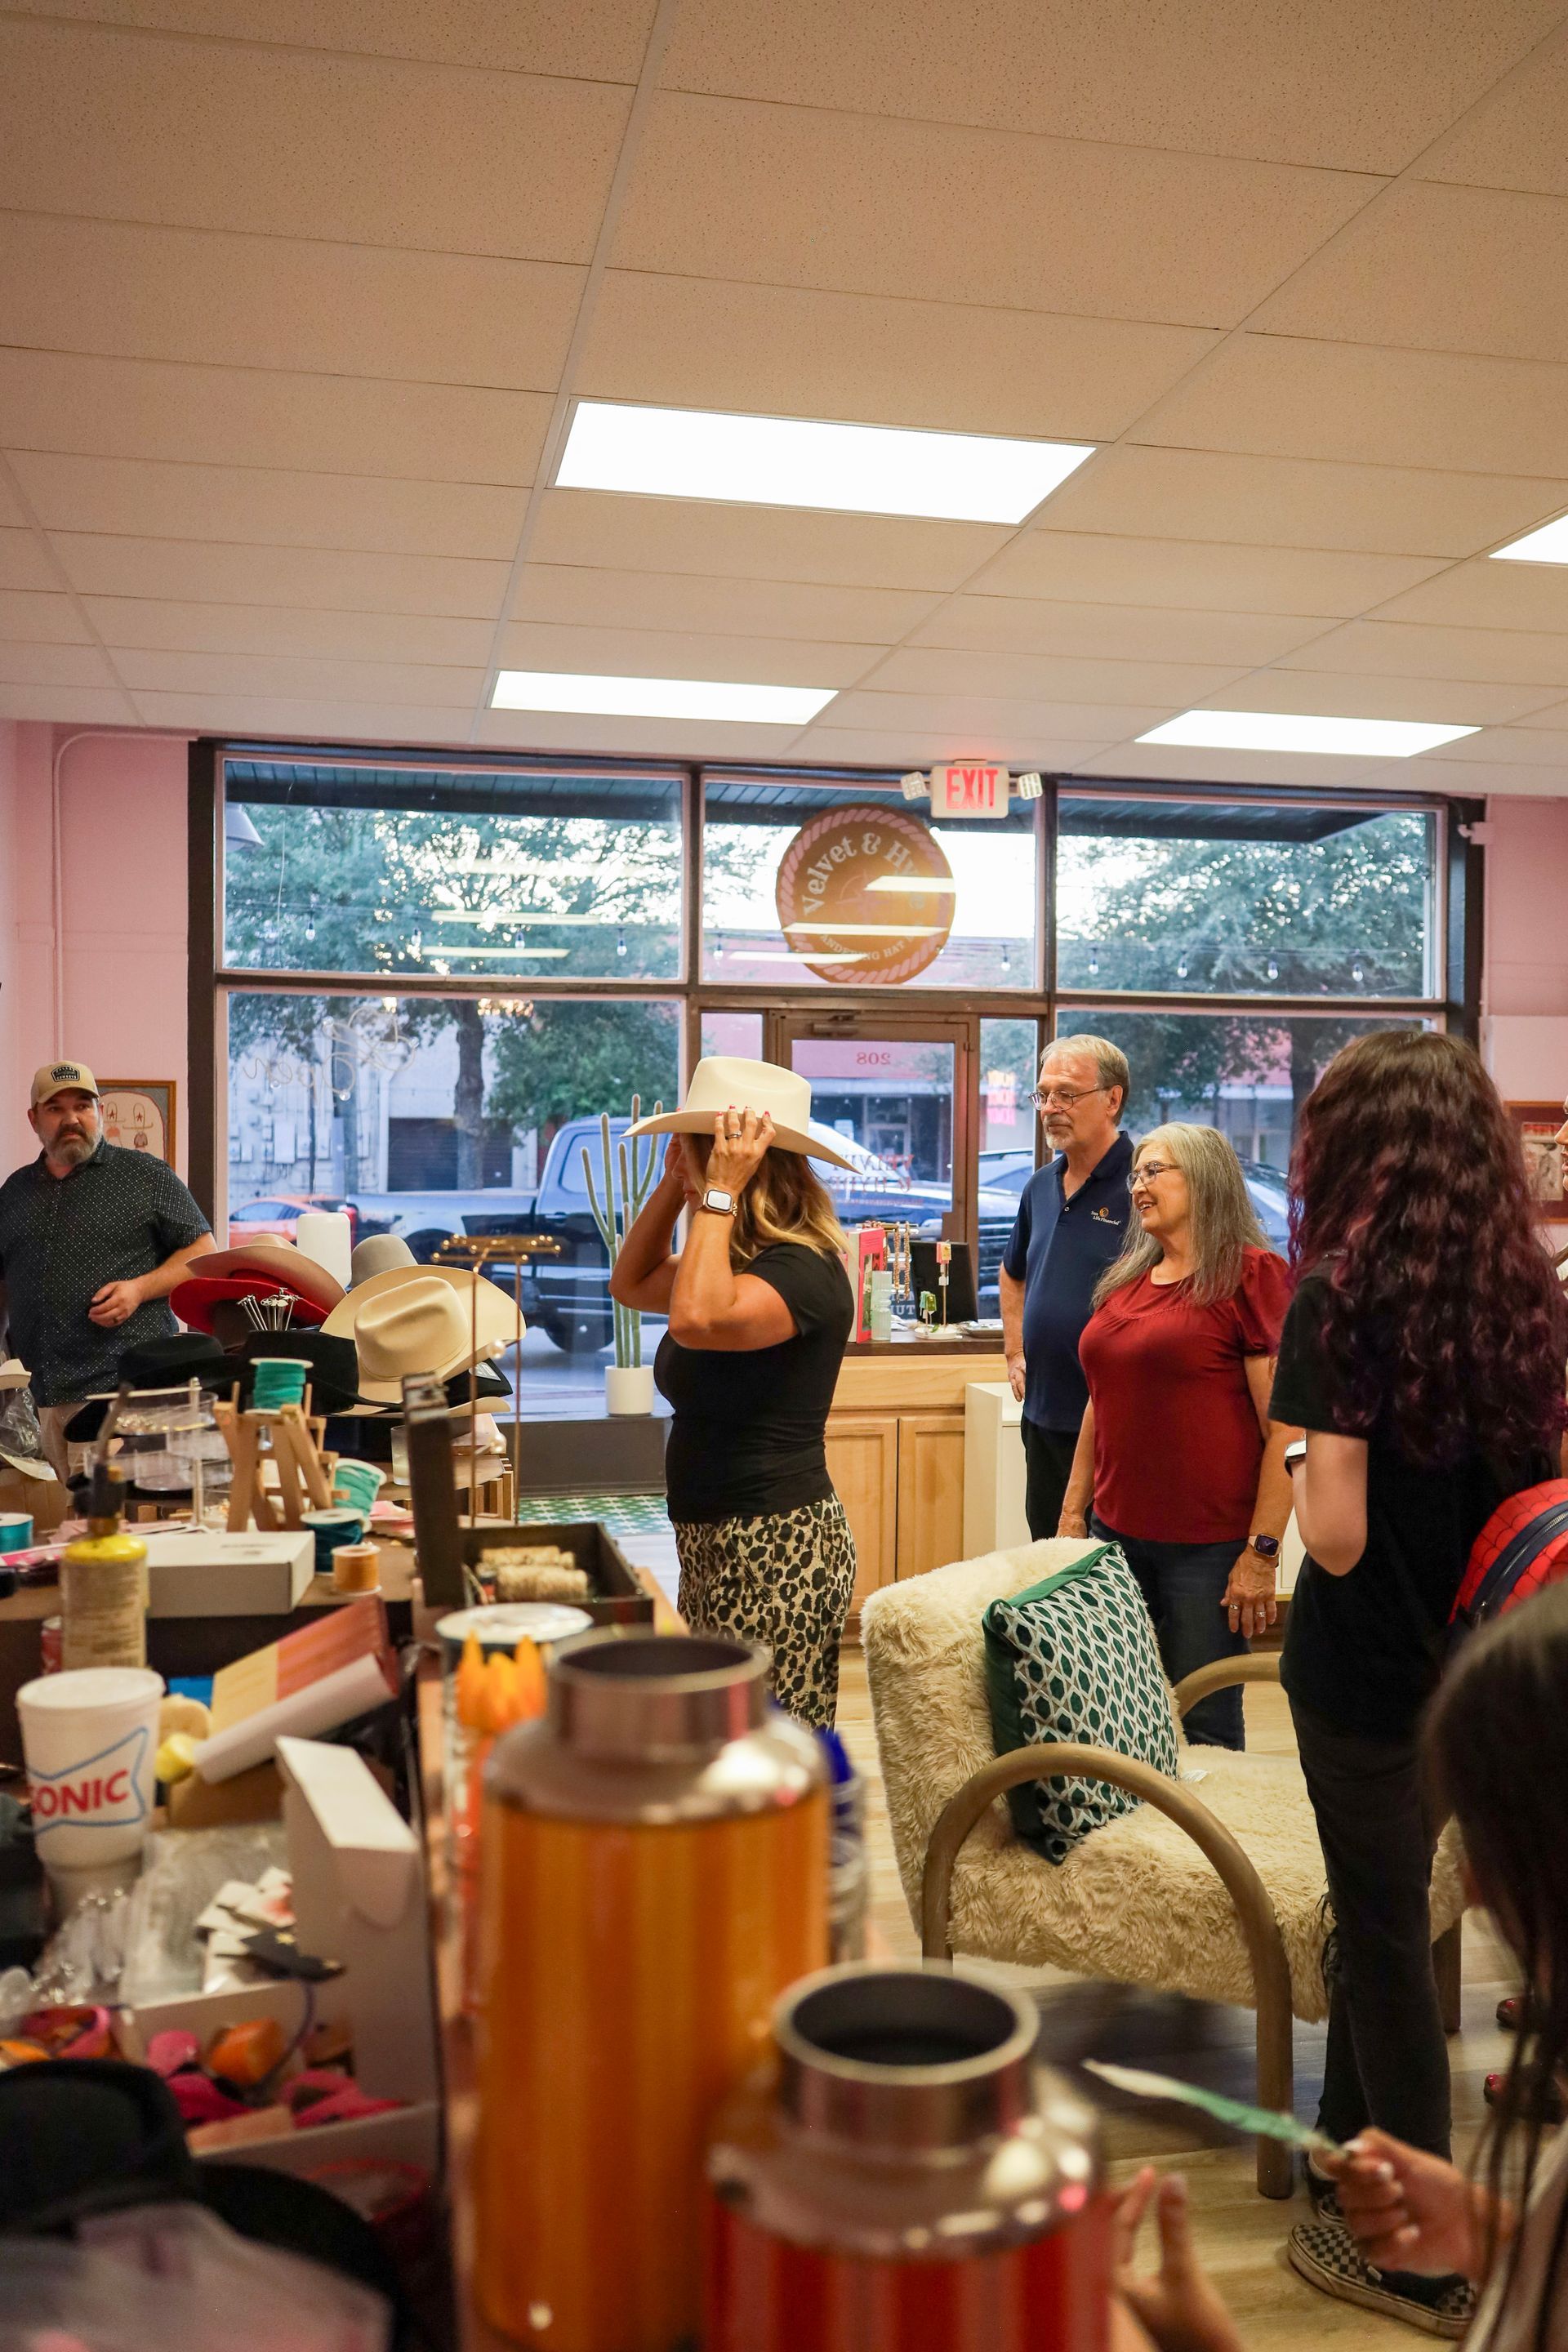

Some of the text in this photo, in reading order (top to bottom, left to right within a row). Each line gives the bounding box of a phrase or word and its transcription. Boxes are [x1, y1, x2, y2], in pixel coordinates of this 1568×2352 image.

[946, 768, 998, 809] EXIT
[801, 835, 858, 915] Velvet
[862, 832, 882, 855] &
[883, 940, 905, 959] HAT
